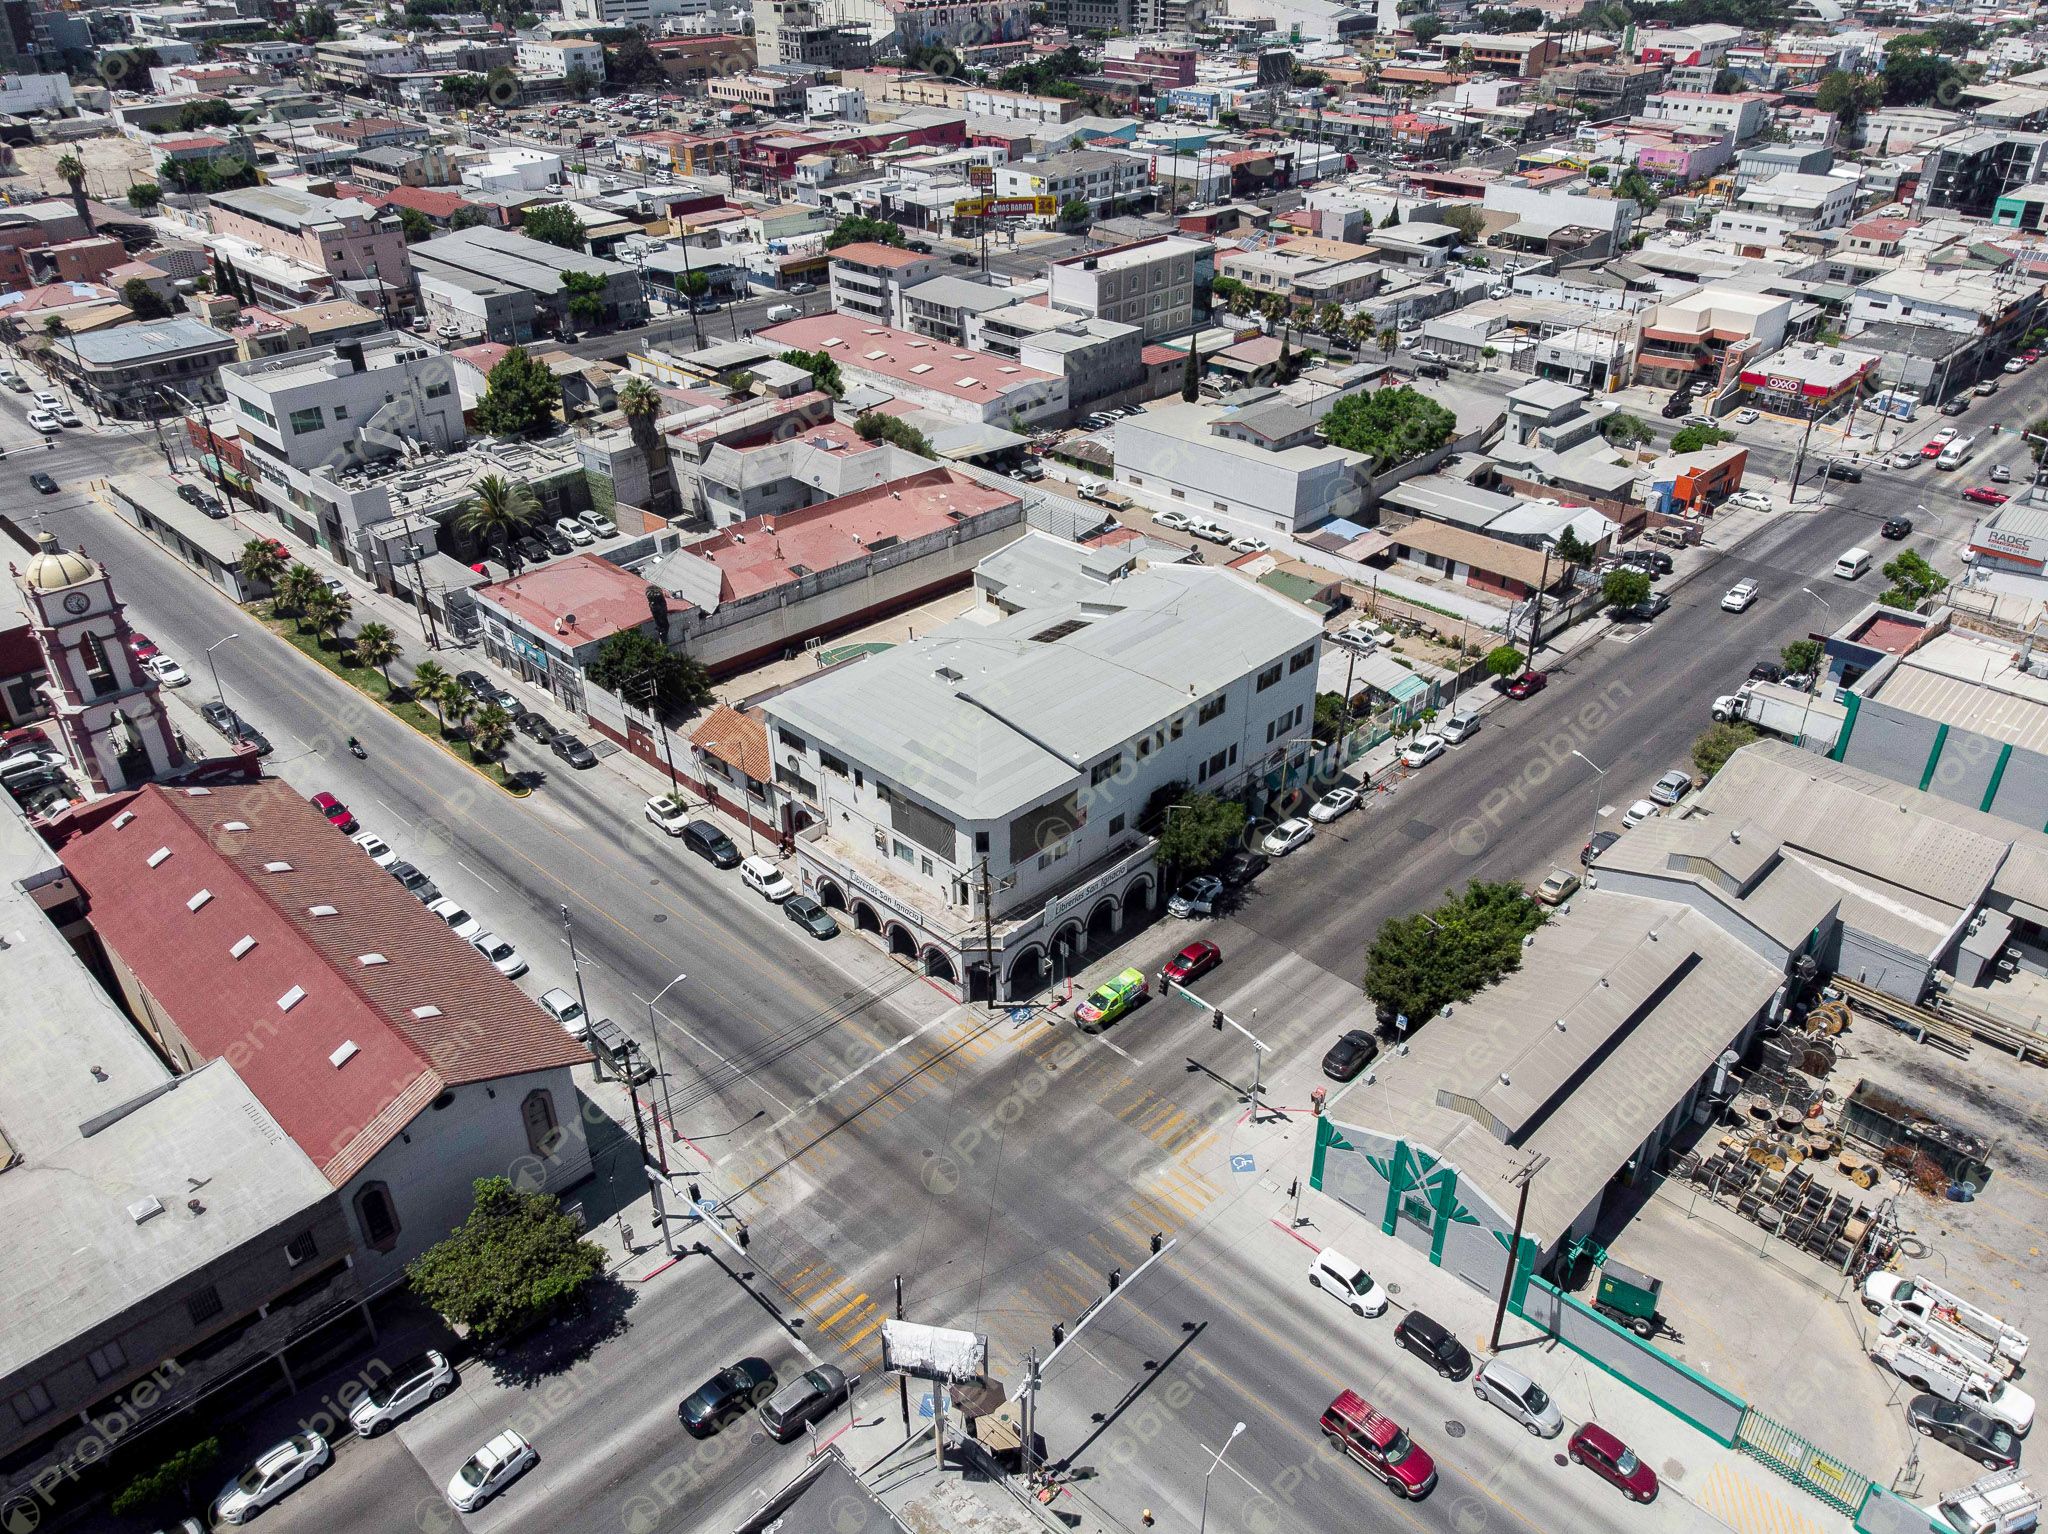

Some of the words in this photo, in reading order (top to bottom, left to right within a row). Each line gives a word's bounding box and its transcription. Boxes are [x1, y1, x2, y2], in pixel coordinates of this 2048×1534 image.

[929, 8, 955, 27] JAI
[997, 203, 1010, 212] MAS
[1010, 202, 1034, 212] BARATA
[1770, 378, 1798, 391] OXXO
[1989, 531, 2032, 548] RADEC
[1085, 883, 1099, 896] San
[1100, 865, 1126, 888] Ignacio
[880, 889, 893, 904] San
[894, 899, 919, 922] Ignacio
